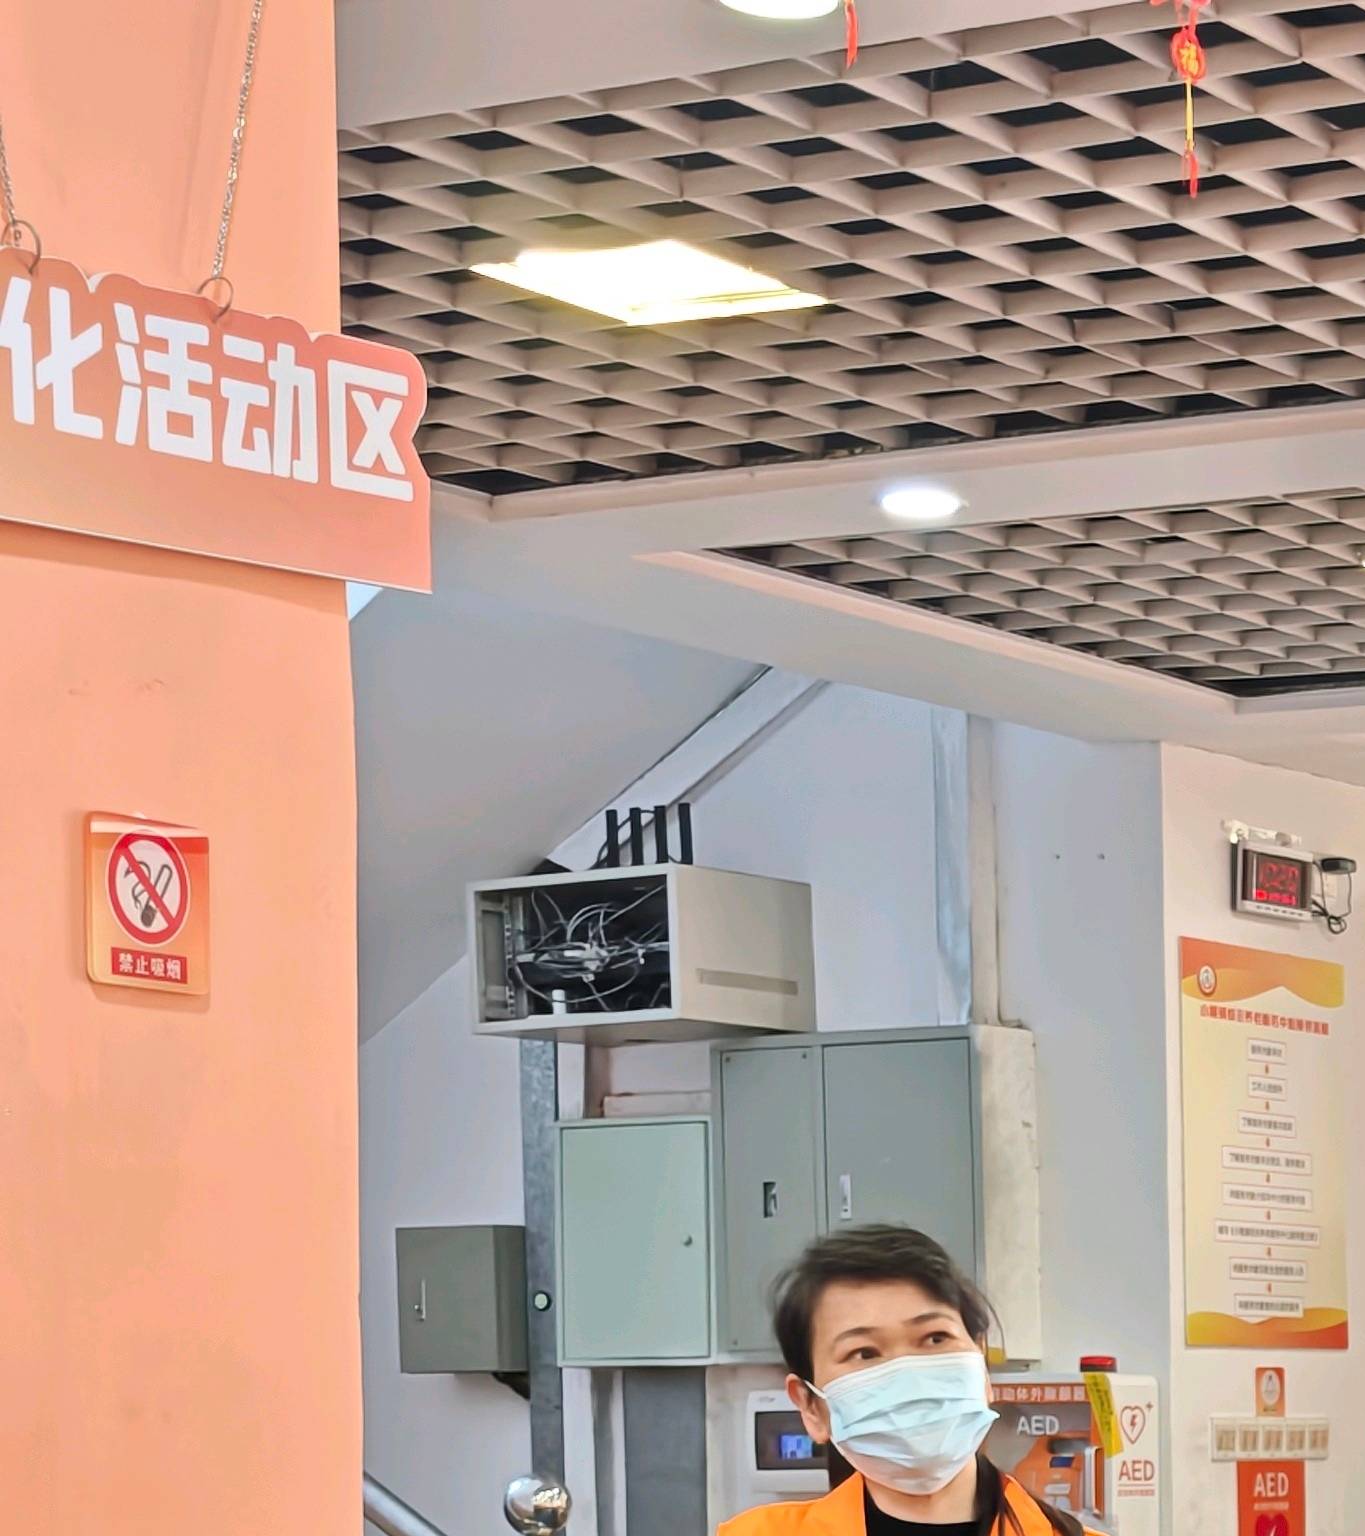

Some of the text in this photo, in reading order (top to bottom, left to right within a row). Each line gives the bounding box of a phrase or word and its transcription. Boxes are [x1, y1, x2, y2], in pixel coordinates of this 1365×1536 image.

[0, 276, 414, 502] 化活动区
[119, 952, 182, 980] 禁止吸烟
[1017, 1414, 1060, 1436] AED
[1118, 1460, 1155, 1481] AED
[1253, 1471, 1289, 1498] AED
